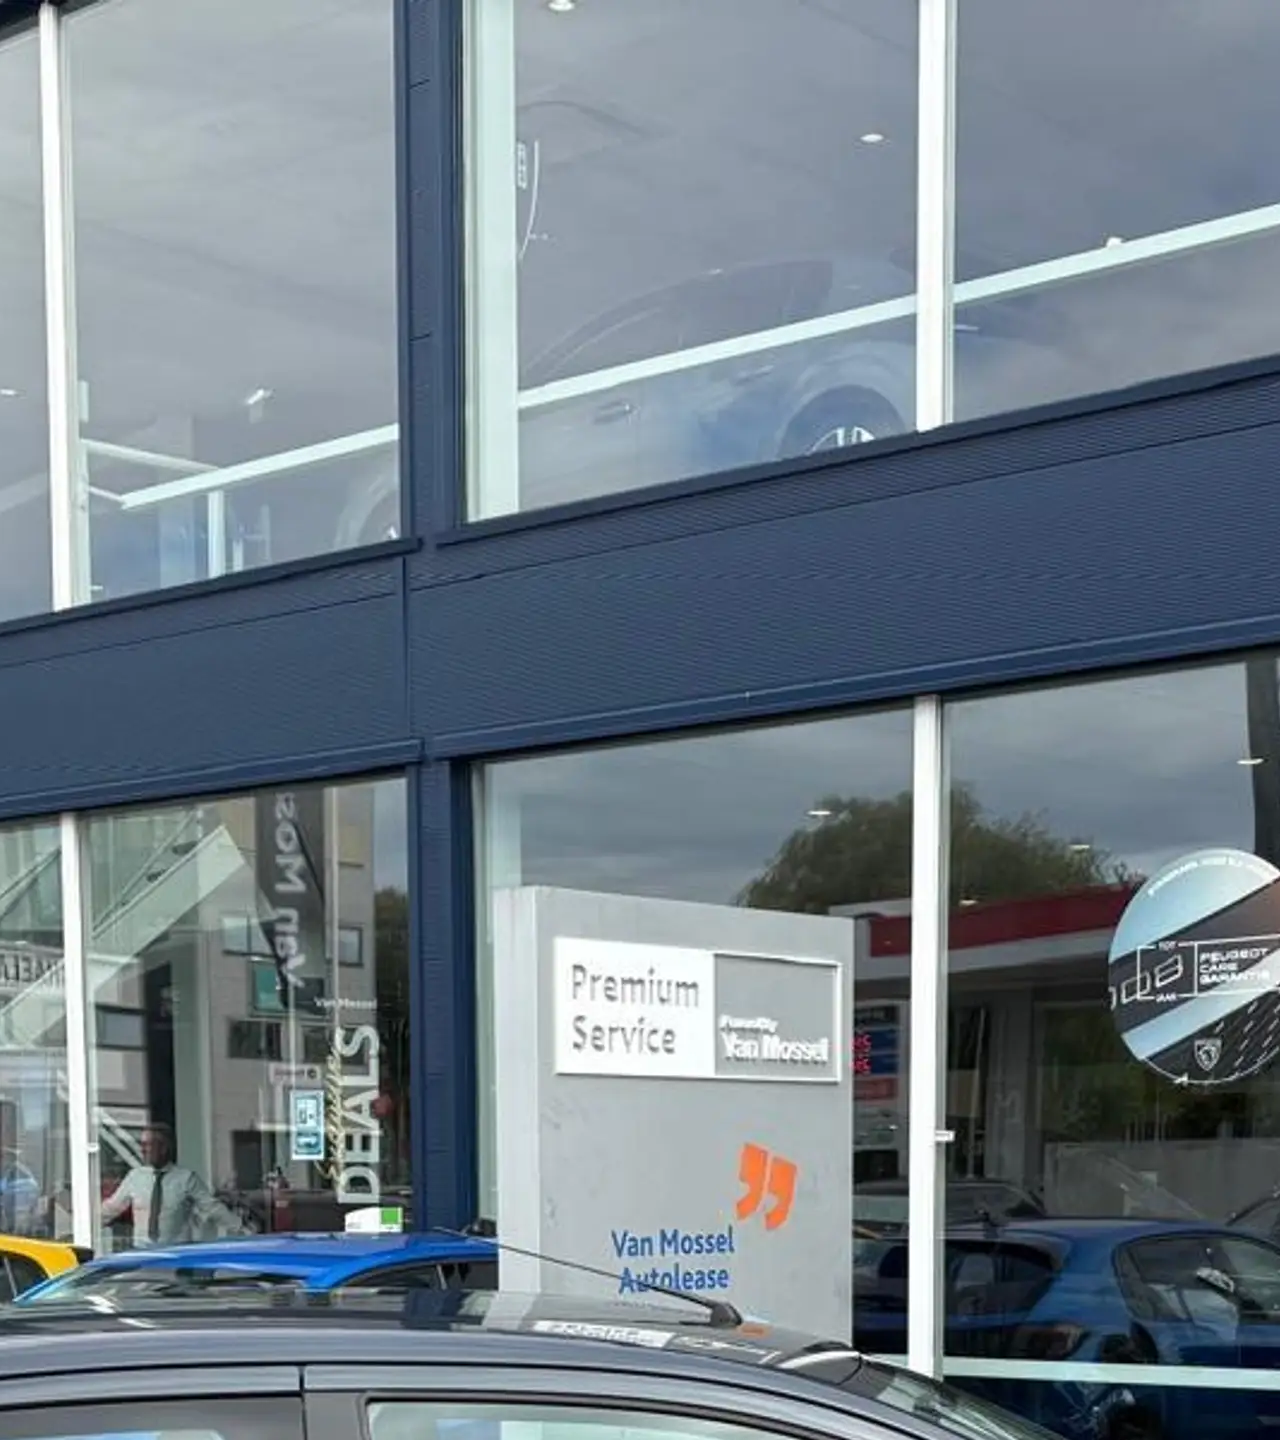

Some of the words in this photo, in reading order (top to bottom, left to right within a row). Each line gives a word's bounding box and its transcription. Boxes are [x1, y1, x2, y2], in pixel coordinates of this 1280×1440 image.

[1199, 962, 1239, 974] CARE
[1200, 948, 1269, 962] PEUGEOT
[572, 964, 699, 1007] Premium
[1199, 970, 1270, 985] GARANTIE
[572, 1015, 677, 1054] Service
[721, 1030, 759, 1061] Van
[761, 1033, 829, 1064] Mossel
[335, 1023, 380, 1205] DEALS
[611, 1229, 654, 1258] Van
[659, 1223, 736, 1257] Mossel
[618, 1262, 730, 1296] Autolease
